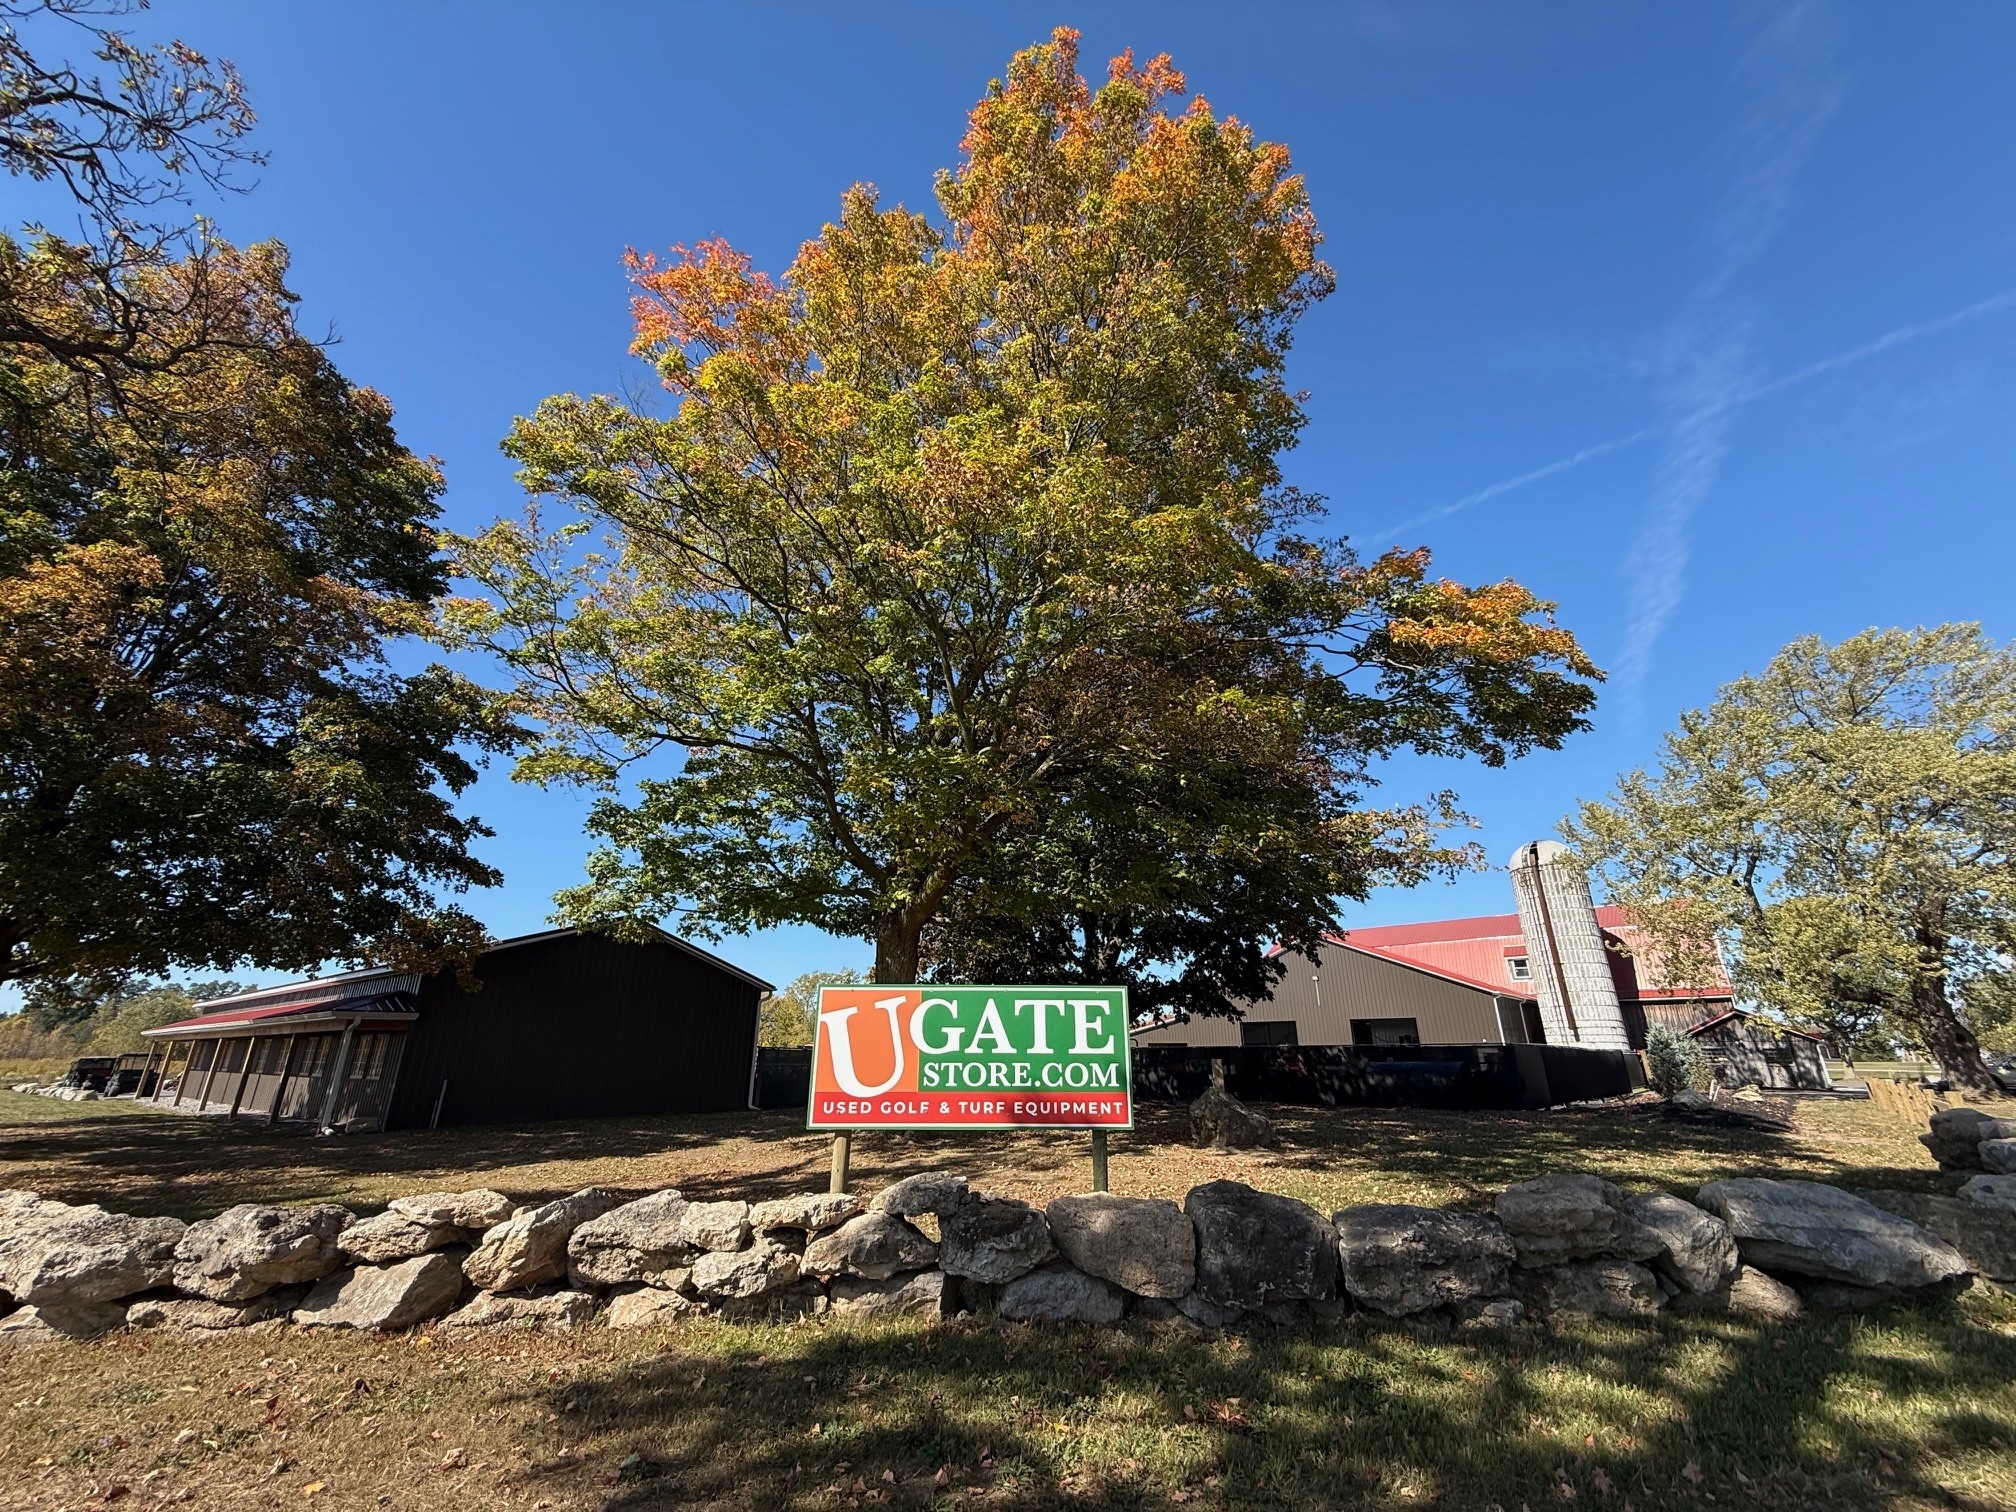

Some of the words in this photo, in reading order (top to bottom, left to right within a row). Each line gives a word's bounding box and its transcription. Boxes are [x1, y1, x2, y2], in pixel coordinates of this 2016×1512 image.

[923, 1062, 1120, 1087] STORE.COM
[823, 1101, 872, 1114] USED
[880, 1101, 929, 1114] GOLF
[939, 1101, 950, 1114] &
[958, 1101, 1006, 1114] TURF
[1013, 1101, 1123, 1116] EQUIPMENT
